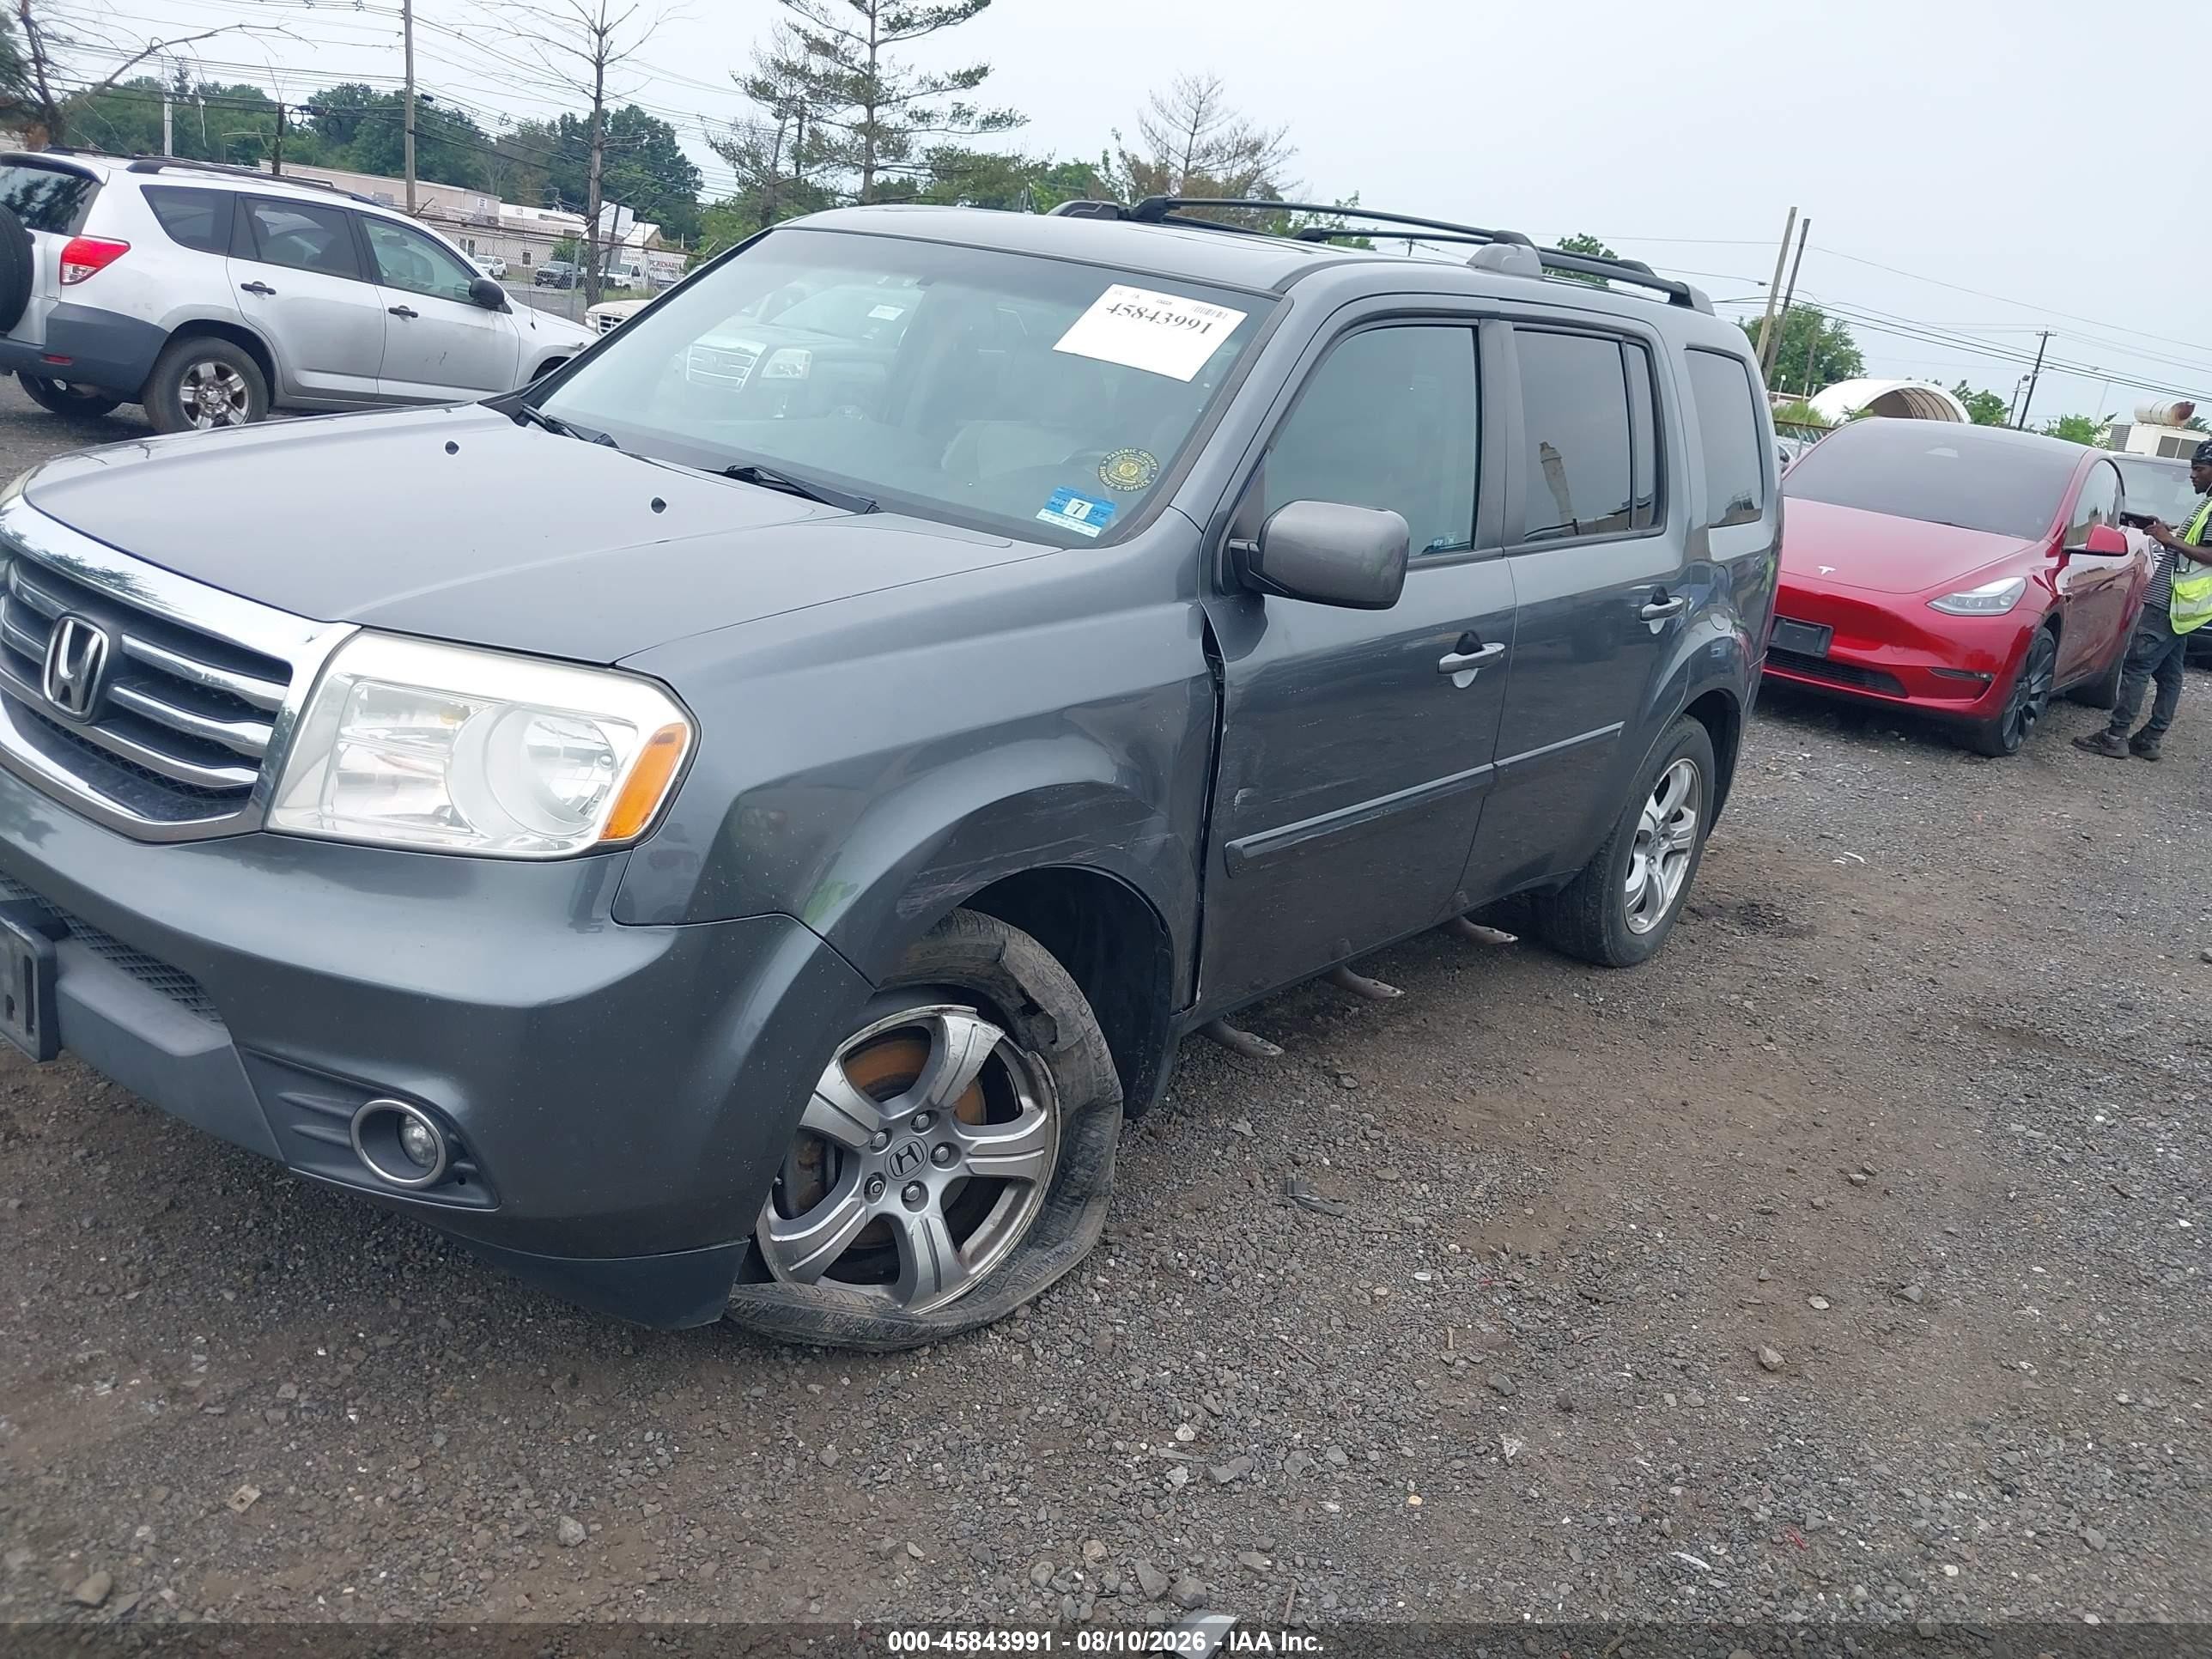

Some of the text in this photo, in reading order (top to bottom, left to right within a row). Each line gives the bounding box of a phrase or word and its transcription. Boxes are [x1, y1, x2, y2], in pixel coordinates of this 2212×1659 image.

[1106, 301, 1213, 335] 45843991
[1106, 448, 1138, 461] PASSAIC
[1139, 450, 1159, 471] COUNTY
[1123, 479, 1152, 491] OFFICE
[1073, 501, 1085, 515] 7
